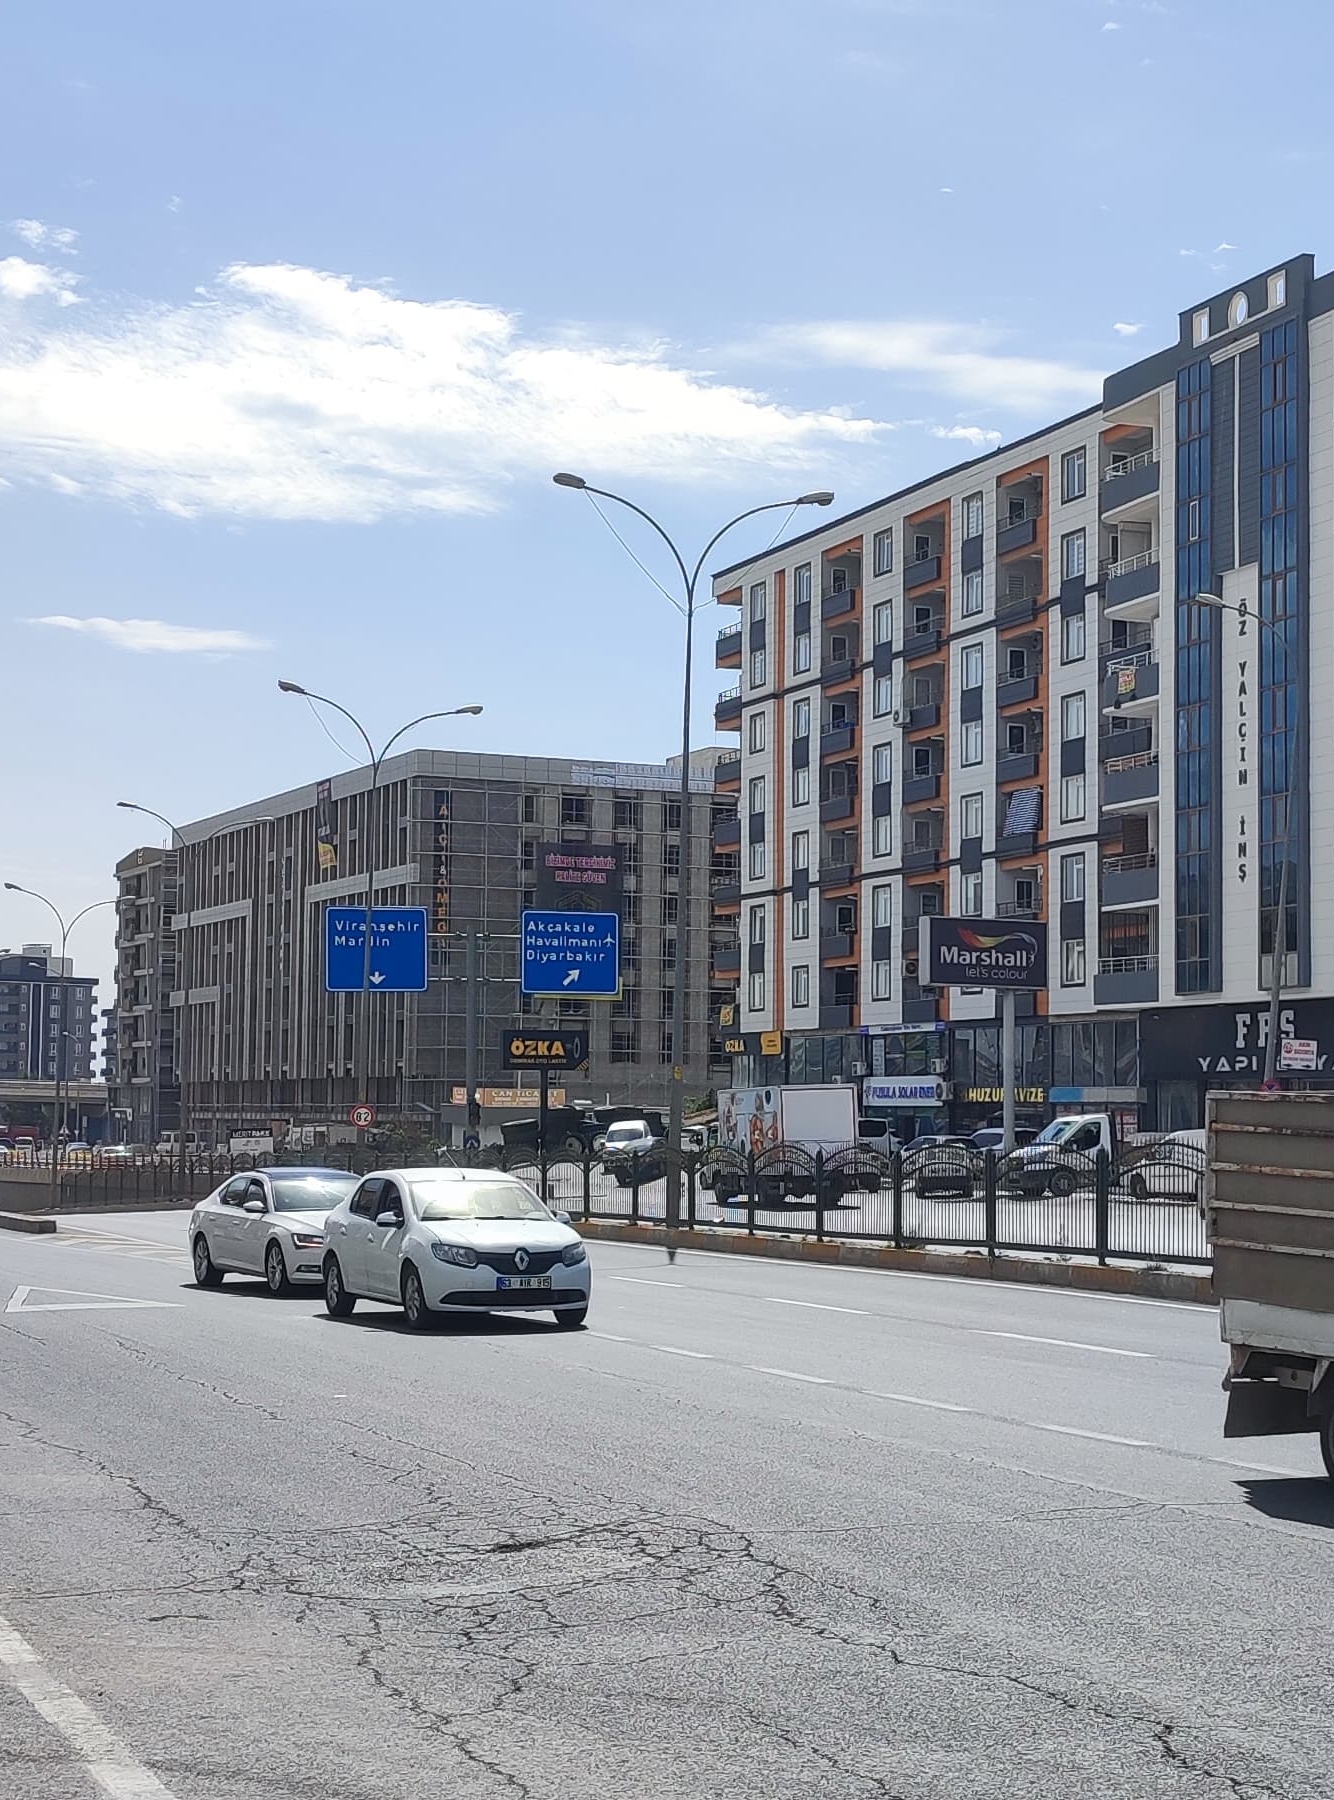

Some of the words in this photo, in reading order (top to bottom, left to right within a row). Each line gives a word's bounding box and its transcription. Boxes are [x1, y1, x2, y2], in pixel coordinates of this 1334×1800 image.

[1238, 660, 1247, 786] YALÇIN
[1238, 815, 1247, 884] İNŞ
[334, 919, 420, 932] Viranşehir
[527, 921, 595, 934] Akçakale
[526, 936, 603, 947] Havalimanı
[526, 950, 606, 965] Diyarbakır
[939, 945, 1027, 967] Marshall
[965, 967, 989, 978] let's
[990, 968, 1028, 980] colour
[510, 1037, 565, 1057] ÖZKA
[1198, 1055, 1258, 1072] YAPI
